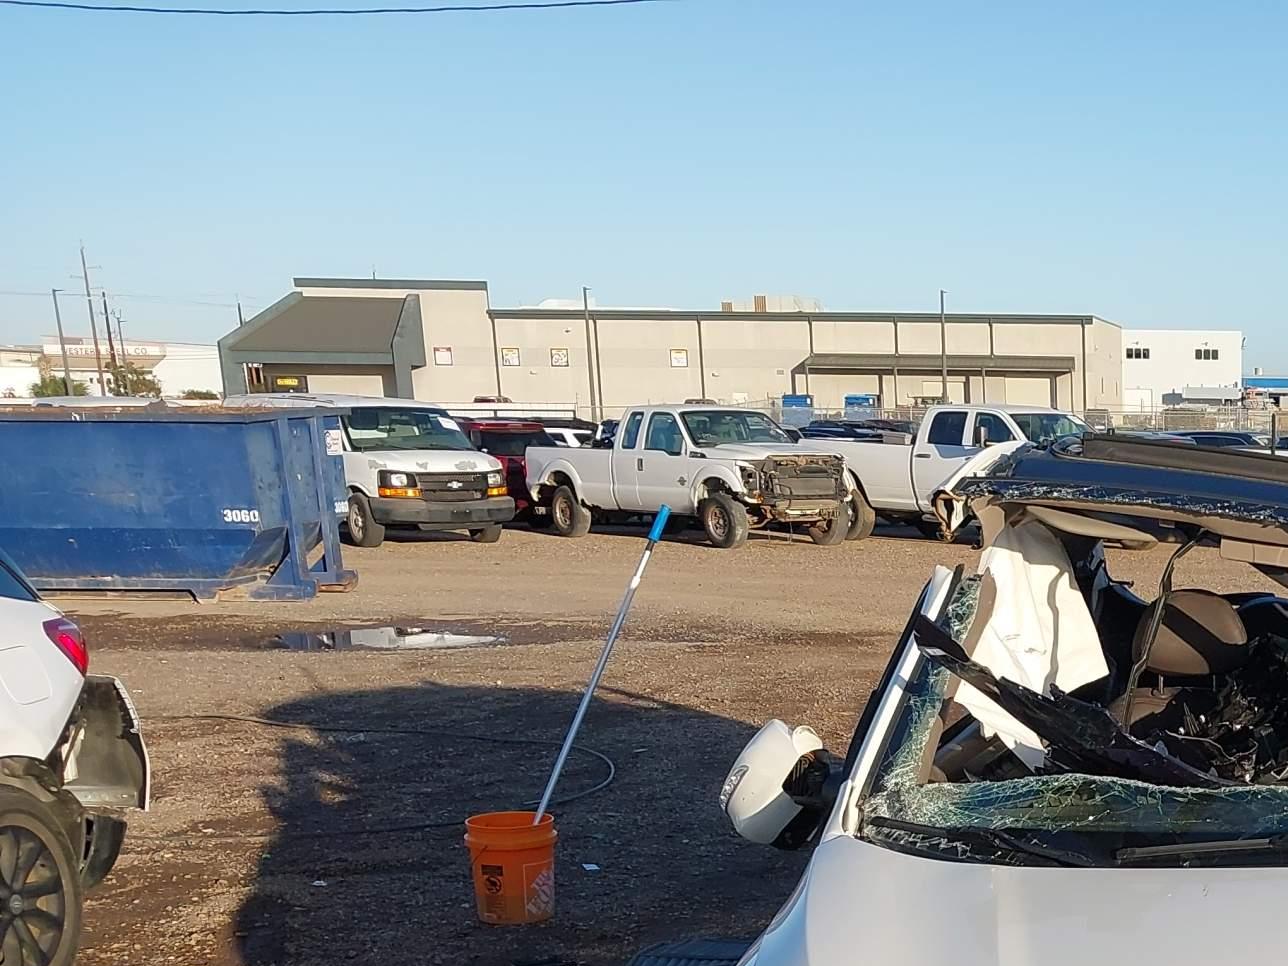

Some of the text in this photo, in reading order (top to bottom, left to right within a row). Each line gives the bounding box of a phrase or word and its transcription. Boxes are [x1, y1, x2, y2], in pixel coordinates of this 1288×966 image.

[64, 347, 98, 355] ESTER
[105, 347, 129, 355] SEL
[223, 509, 259, 522] 3060
